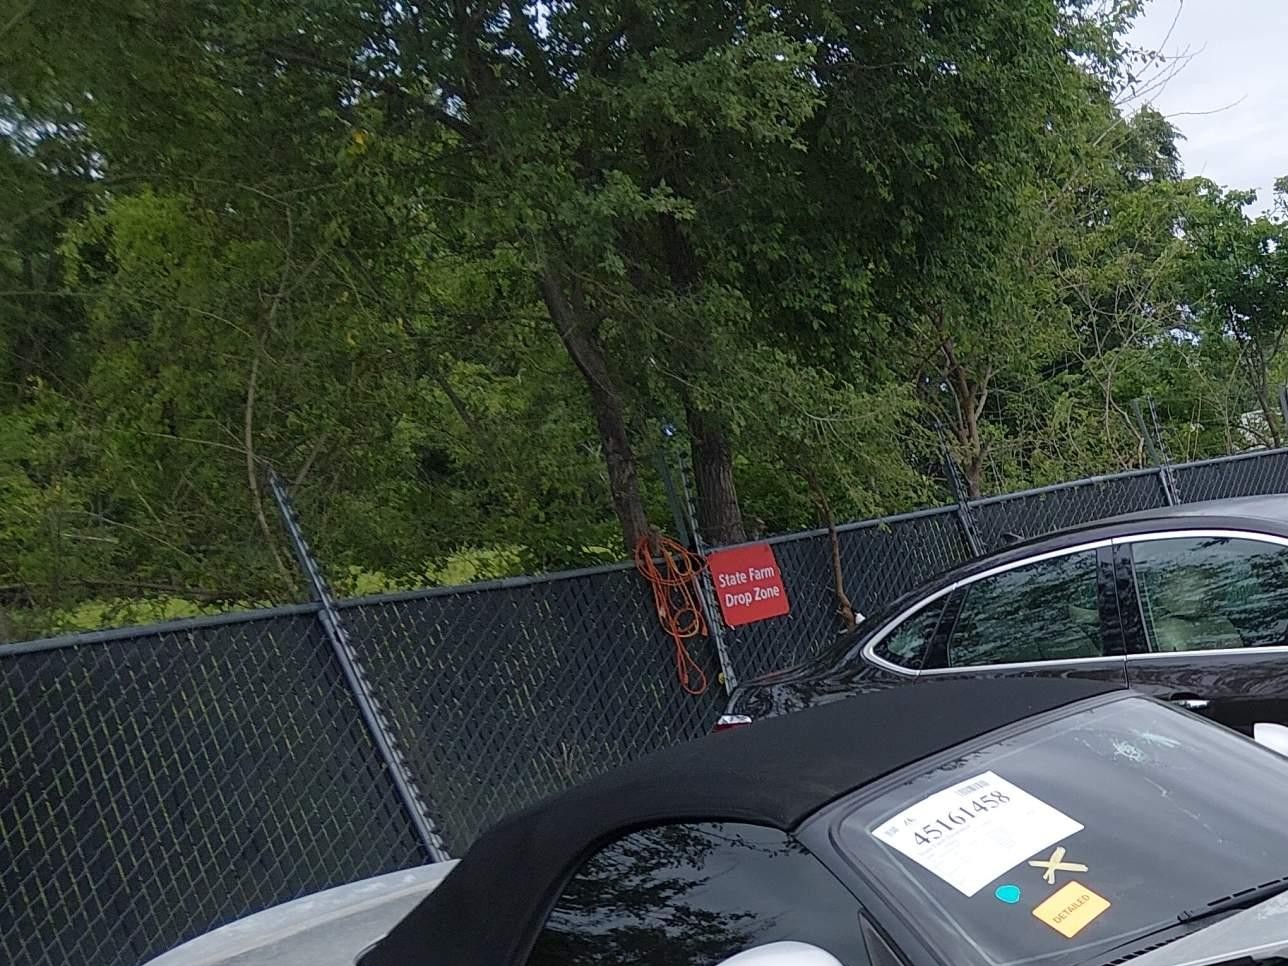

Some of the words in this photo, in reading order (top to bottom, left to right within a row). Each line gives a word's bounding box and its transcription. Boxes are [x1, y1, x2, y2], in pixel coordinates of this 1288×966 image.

[719, 573, 747, 588] State
[749, 566, 775, 581] Farm
[725, 591, 753, 607] Drop
[753, 586, 780, 601] Zone
[914, 790, 1010, 846] 45161458
[1052, 894, 1090, 924] DETAILED
